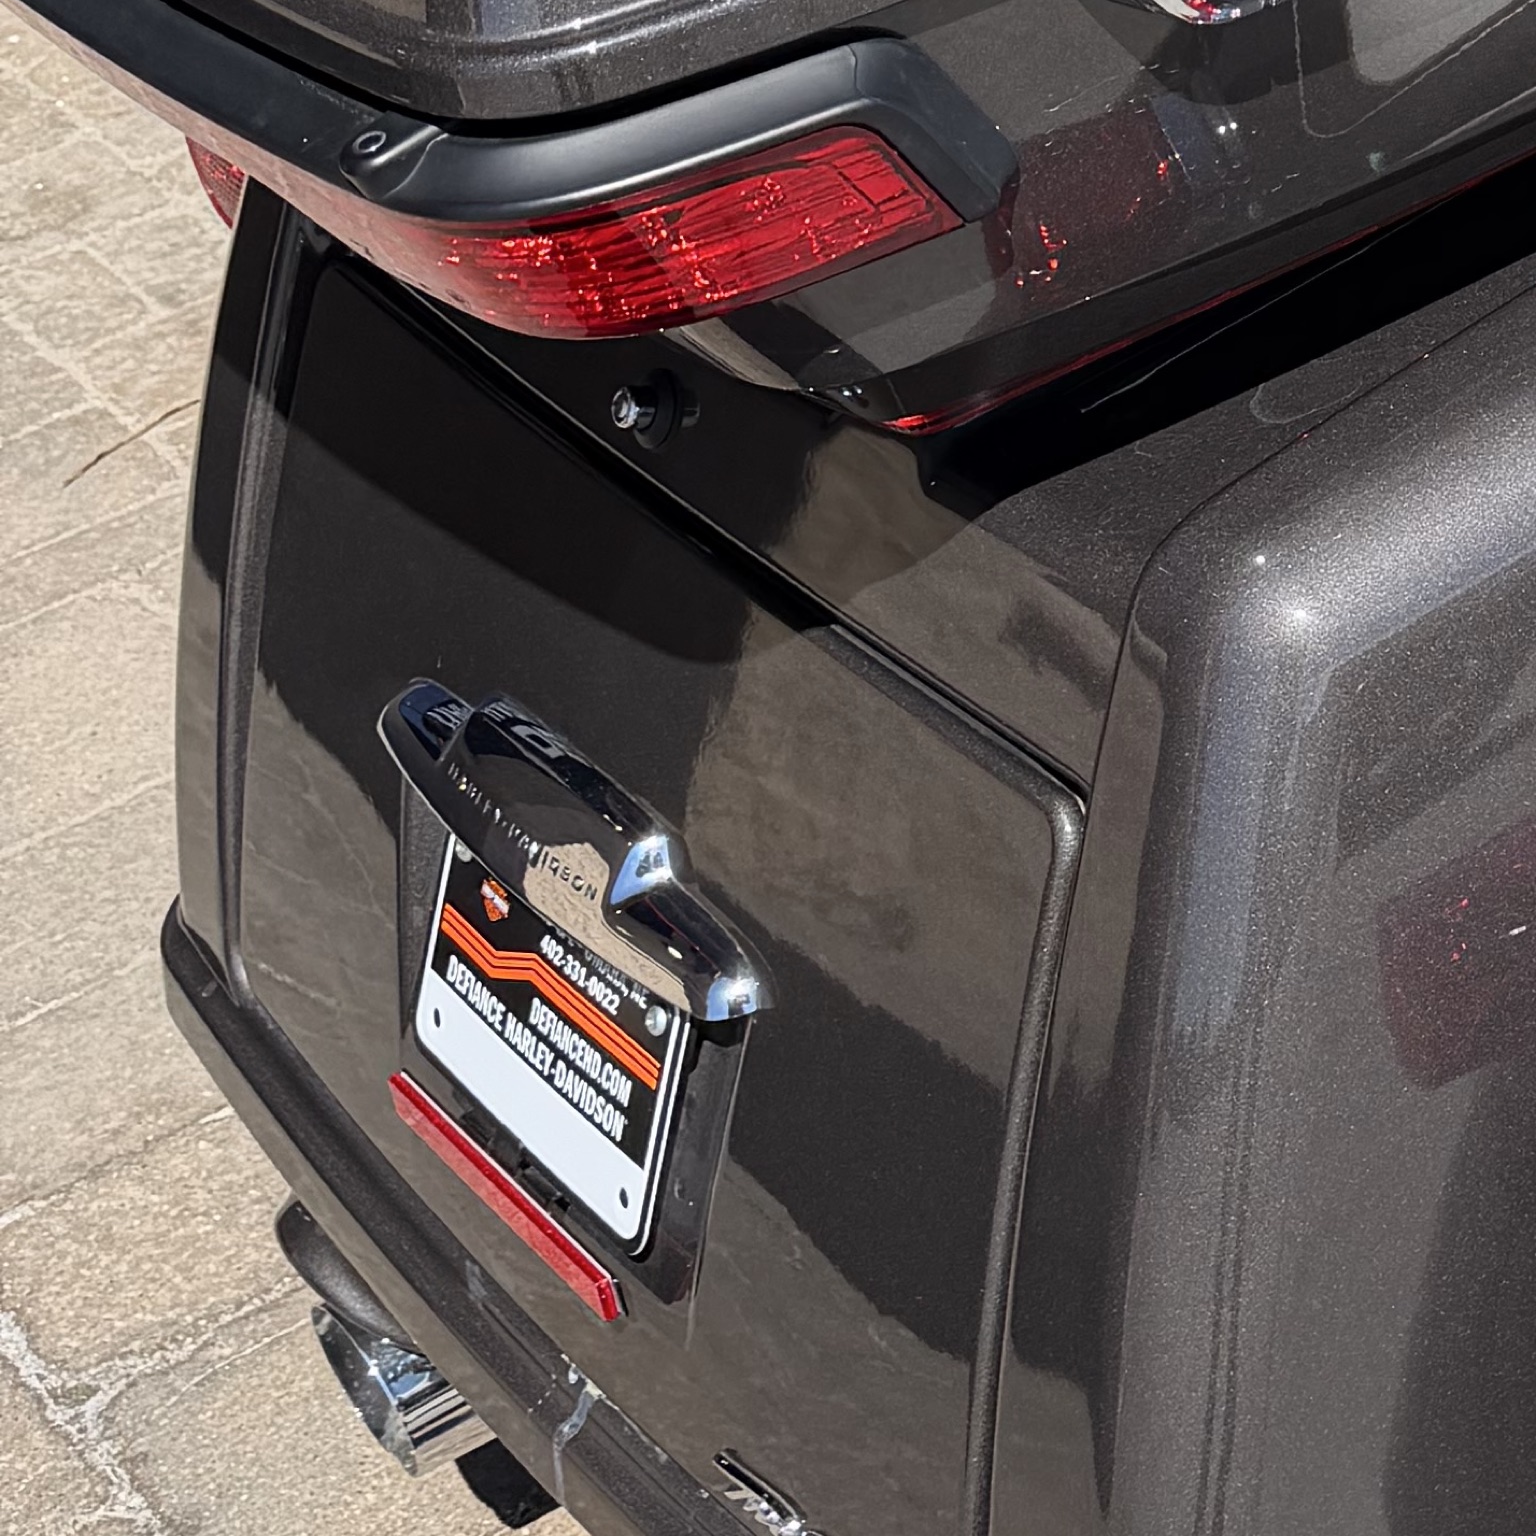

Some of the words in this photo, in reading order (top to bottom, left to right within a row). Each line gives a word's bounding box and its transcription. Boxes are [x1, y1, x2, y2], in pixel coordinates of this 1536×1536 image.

[445, 954, 506, 1032] DEFIANCE
[540, 934, 620, 1016] 402-331-0022
[528, 996, 633, 1108] DEFIANCEHD.COM
